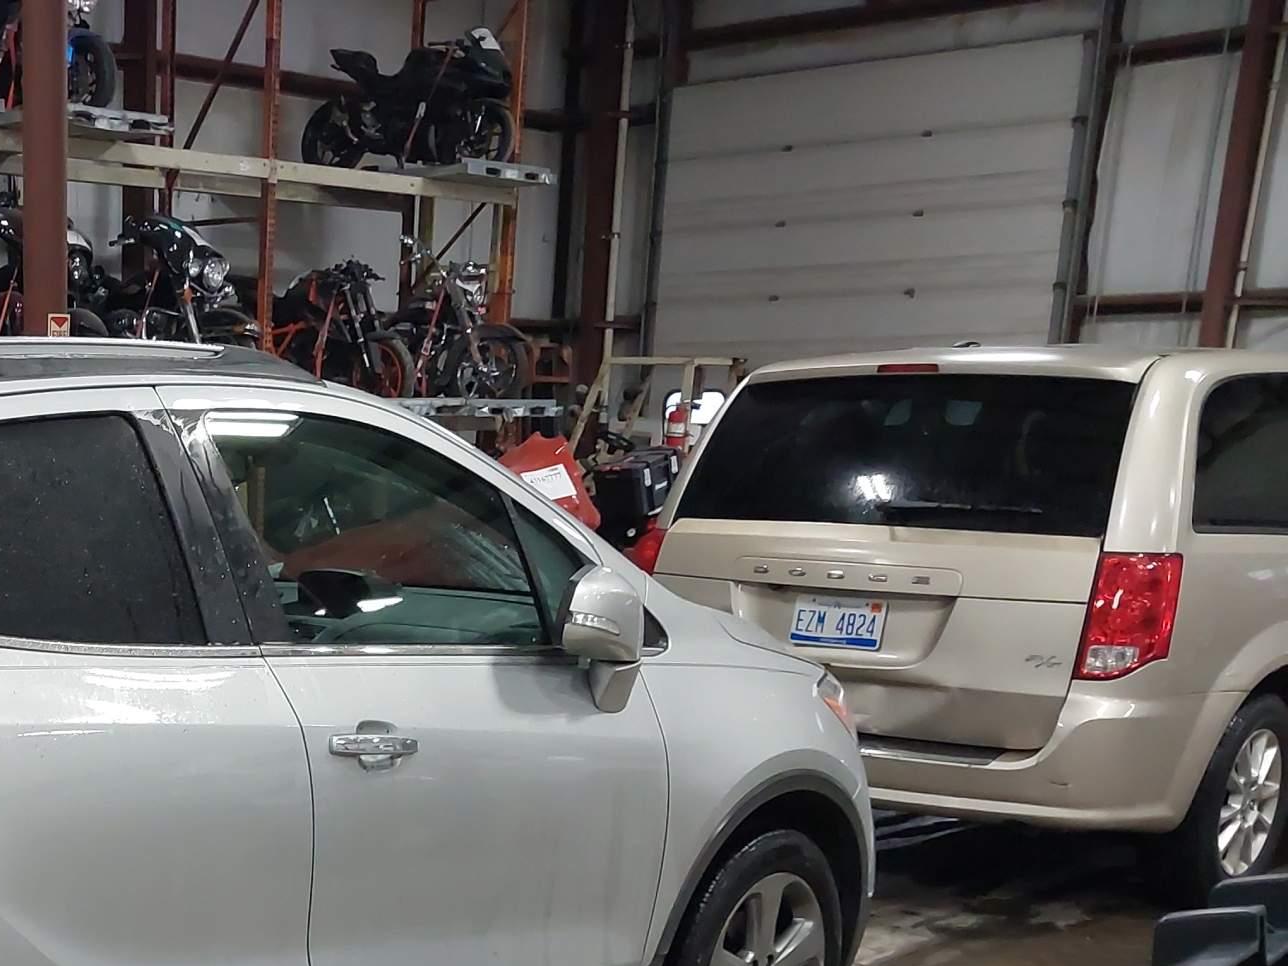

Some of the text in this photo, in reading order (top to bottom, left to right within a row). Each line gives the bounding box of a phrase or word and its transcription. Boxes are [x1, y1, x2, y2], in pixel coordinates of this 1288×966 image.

[753, 564, 930, 586] DODGE
[795, 609, 877, 638] EZM 4824
